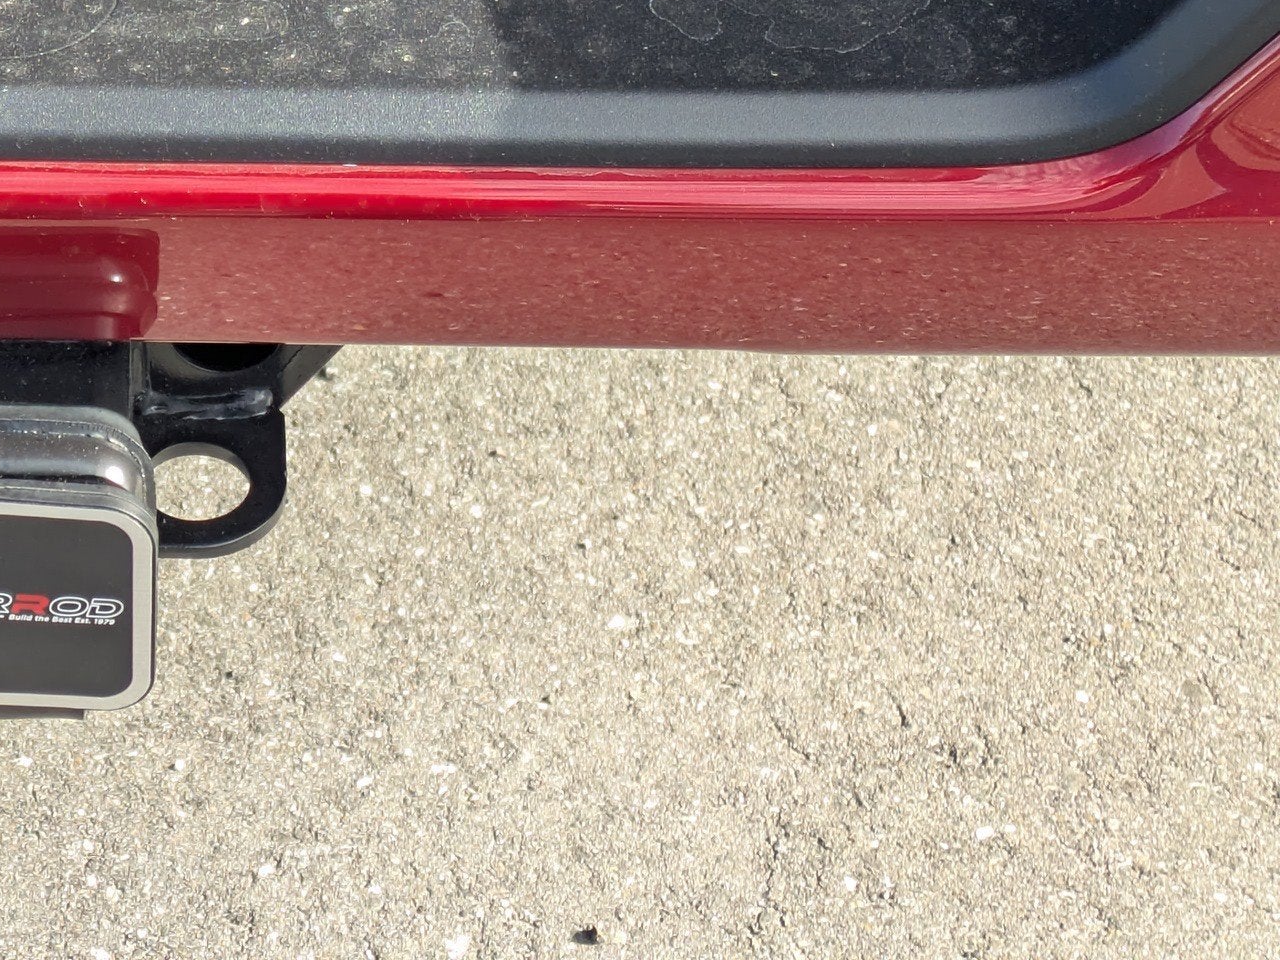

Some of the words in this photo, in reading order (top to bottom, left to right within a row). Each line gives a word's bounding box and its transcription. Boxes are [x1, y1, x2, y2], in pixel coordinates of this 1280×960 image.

[8, 614, 33, 622] Build
[34, 615, 50, 623] the
[94, 618, 115, 626] 1979
